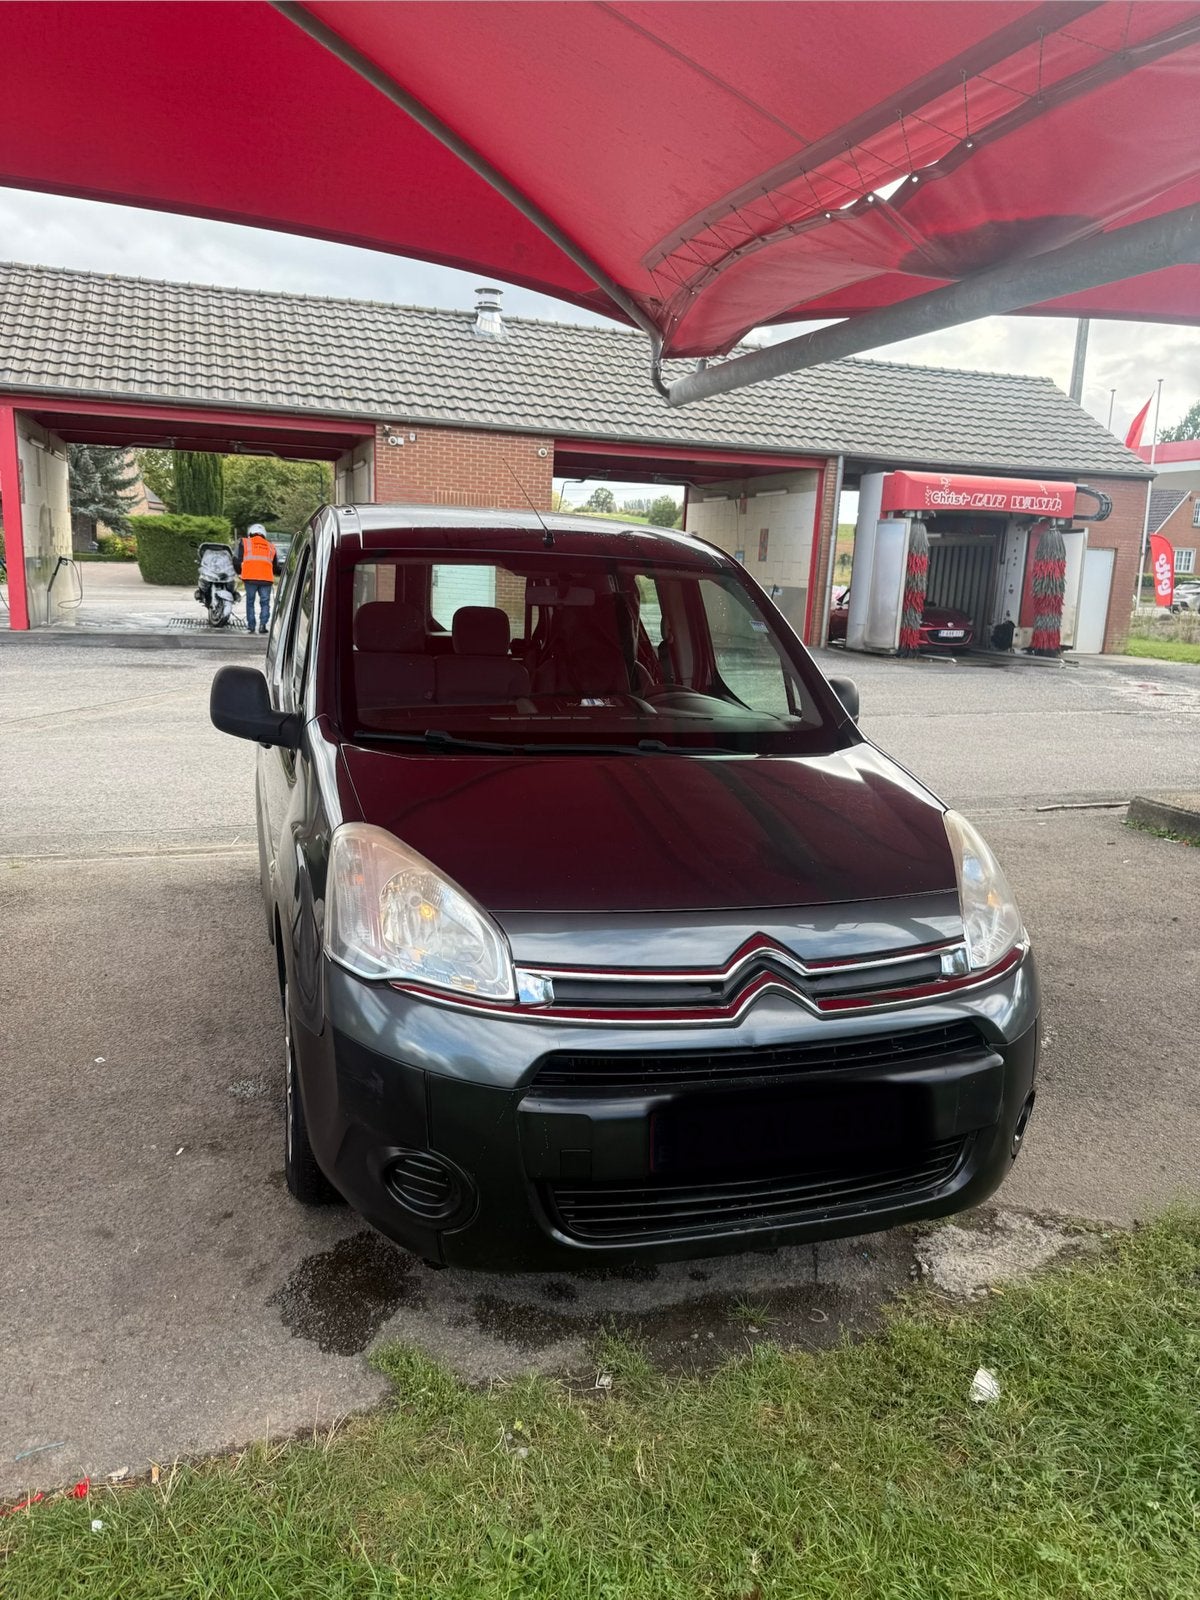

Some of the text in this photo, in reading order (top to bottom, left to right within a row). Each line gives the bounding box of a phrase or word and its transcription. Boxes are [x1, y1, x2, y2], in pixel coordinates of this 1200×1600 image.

[931, 491, 1062, 511] Christ CAR WASH
